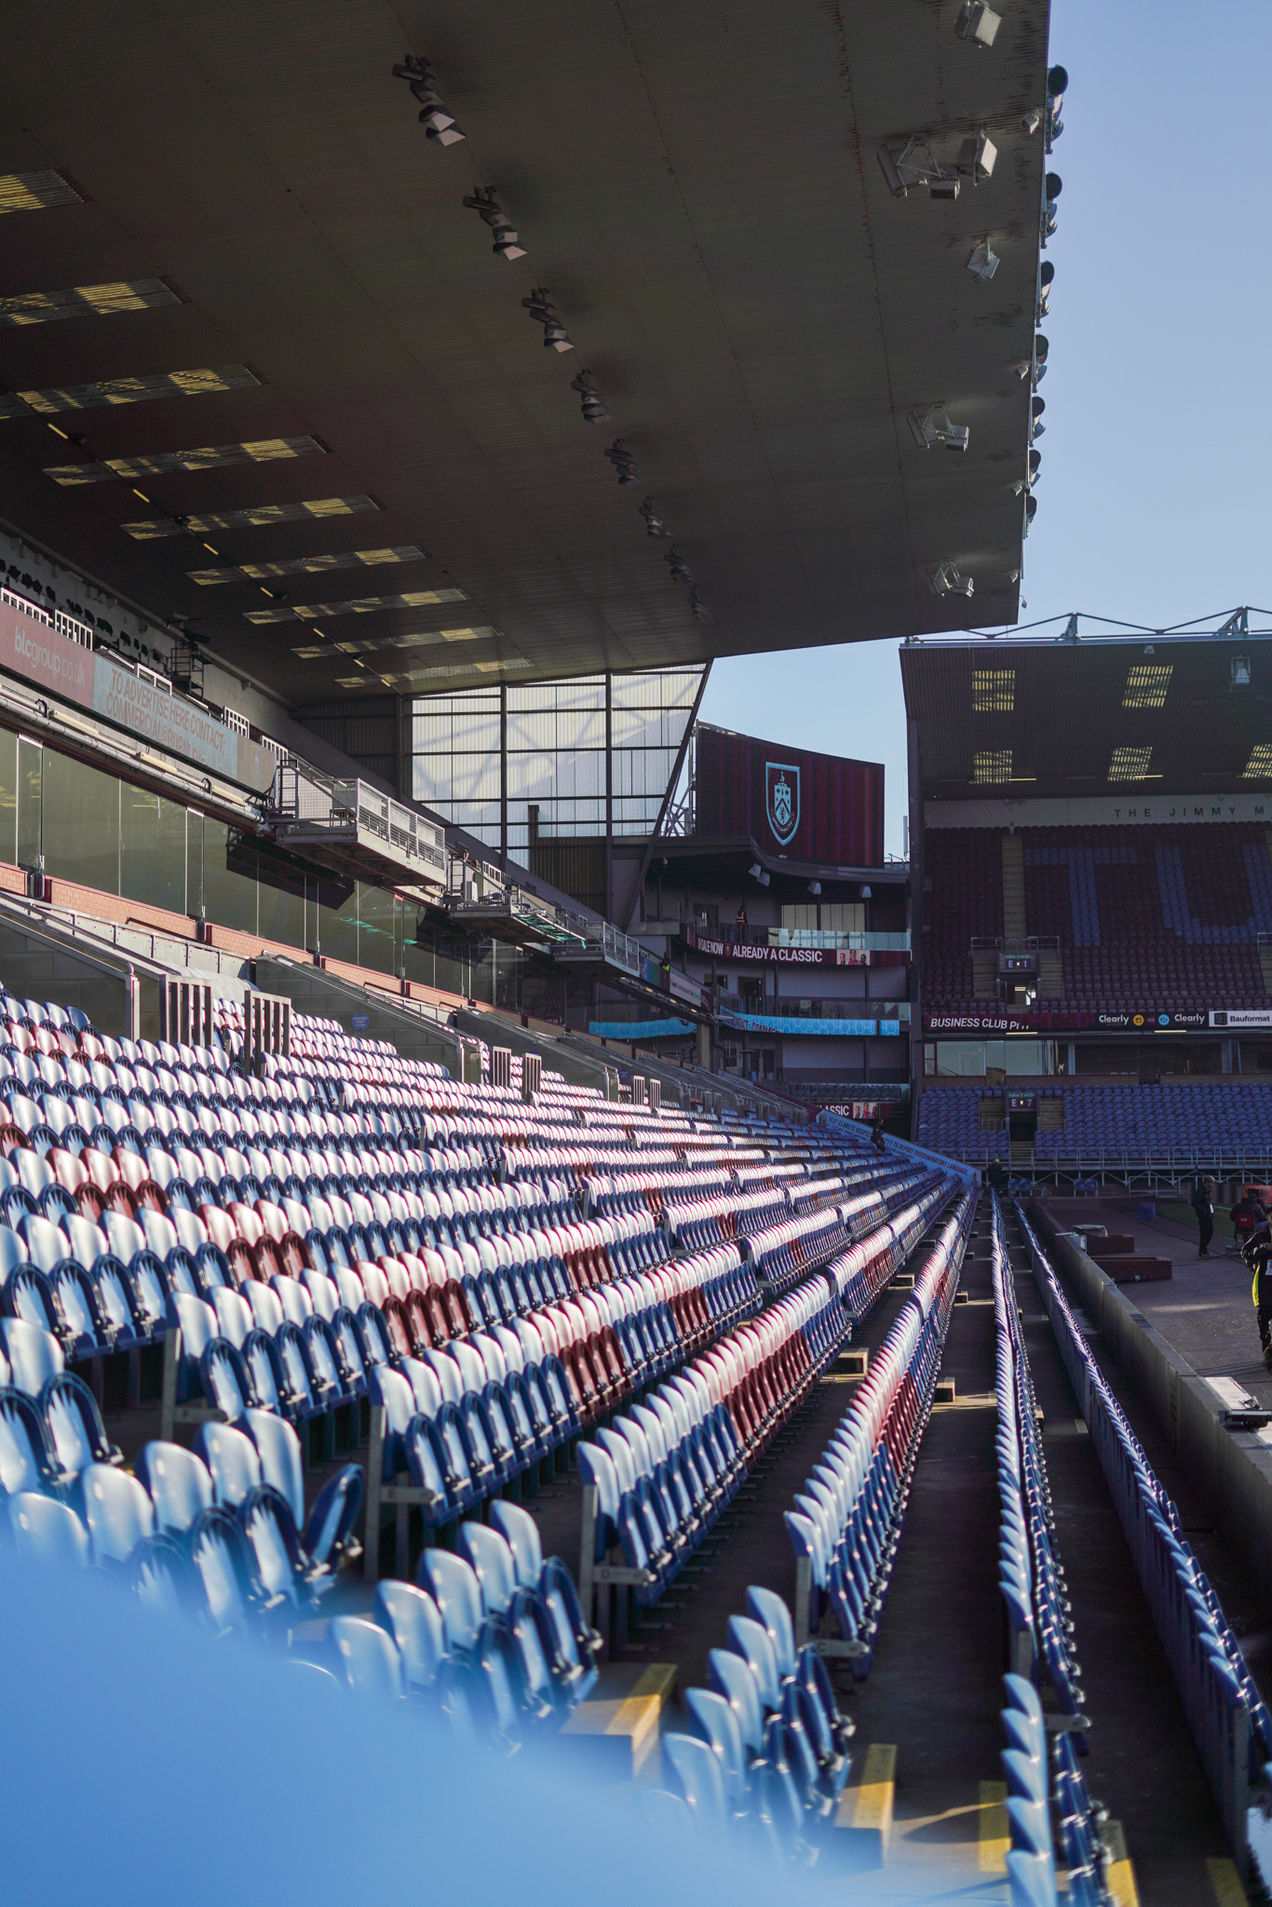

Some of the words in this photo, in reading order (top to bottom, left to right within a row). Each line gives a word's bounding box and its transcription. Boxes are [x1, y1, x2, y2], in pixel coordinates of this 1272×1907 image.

[112, 669, 123, 693] TO
[124, 678, 169, 720] ADVERTISE
[170, 702, 190, 731] HERE
[1114, 808, 1151, 818] THE
[1169, 806, 1236, 817] JIMMY
[732, 944, 769, 960] ALREADY
[770, 949, 778, 960] A
[778, 949, 823, 963] CLASSIC
[930, 1018, 980, 1028] BUSINESS
[981, 1018, 1008, 1030] CLUB
[1098, 1014, 1130, 1026] Clearly
[1174, 1013, 1205, 1025] Clearly
[1230, 1015, 1271, 1023] Bauformat
